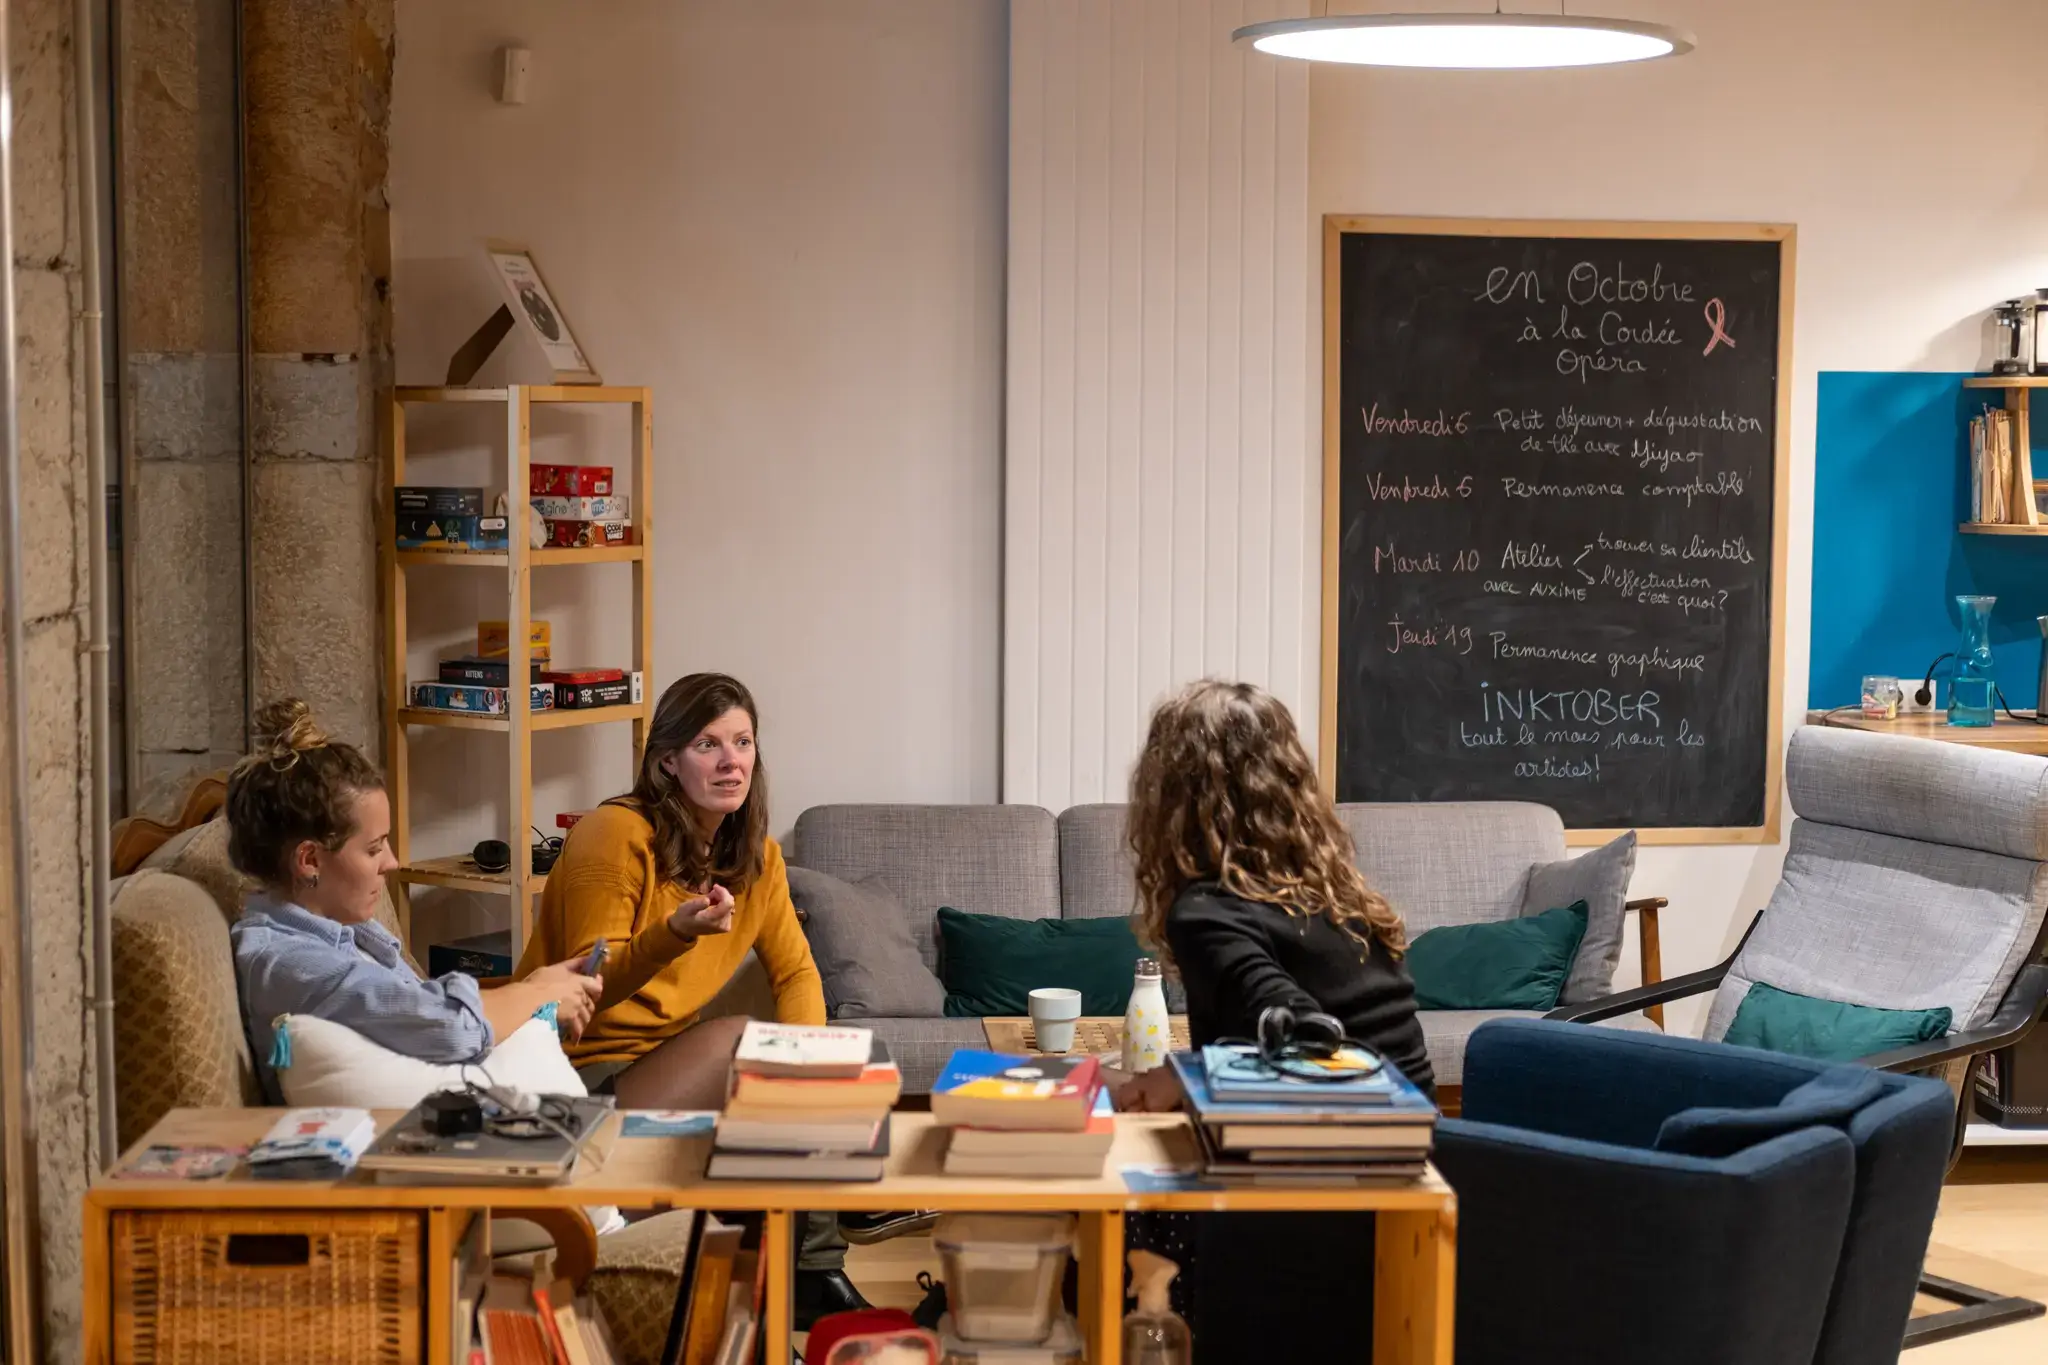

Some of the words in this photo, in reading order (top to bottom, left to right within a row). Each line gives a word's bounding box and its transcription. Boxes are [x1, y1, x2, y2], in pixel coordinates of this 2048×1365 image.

[1473, 266, 1546, 304] en
[1567, 260, 1696, 306] Octobre
[1517, 316, 1542, 343] à
[1552, 304, 1587, 339] la
[1600, 311, 1682, 345] Cordée
[1556, 348, 1647, 384] Opéra
[1362, 402, 1453, 437] Vendredi
[1455, 411, 1471, 434] 6
[1493, 408, 1545, 432] Petit
[1555, 404, 1623, 435] déjeuner
[1643, 405, 1763, 435] dégustation
[1520, 433, 1544, 452] de
[1547, 434, 1578, 454] thé
[1584, 440, 1621, 457] avec
[1366, 472, 1450, 503] Vendredi
[1456, 475, 1473, 498] 6
[1501, 477, 1624, 498] Permanence
[1374, 542, 1442, 574] Mardi
[1452, 549, 1480, 572] 10
[1501, 540, 1563, 569] Atelier
[1597, 531, 1655, 554] trouver
[1660, 542, 1678, 557] sa
[1483, 579, 1522, 595] avec
[1677, 589, 1729, 616] quoi?
[1387, 613, 1438, 654] Jeudi
[1444, 624, 1473, 655] 19
[1489, 631, 1597, 664] Permanence
[1607, 646, 1705, 681] graphique
[1461, 721, 1508, 746] tout
[1515, 723, 1536, 747] le
[1544, 730, 1601, 745] mois
[1610, 731, 1665, 749] pour
[1676, 718, 1705, 747] les
